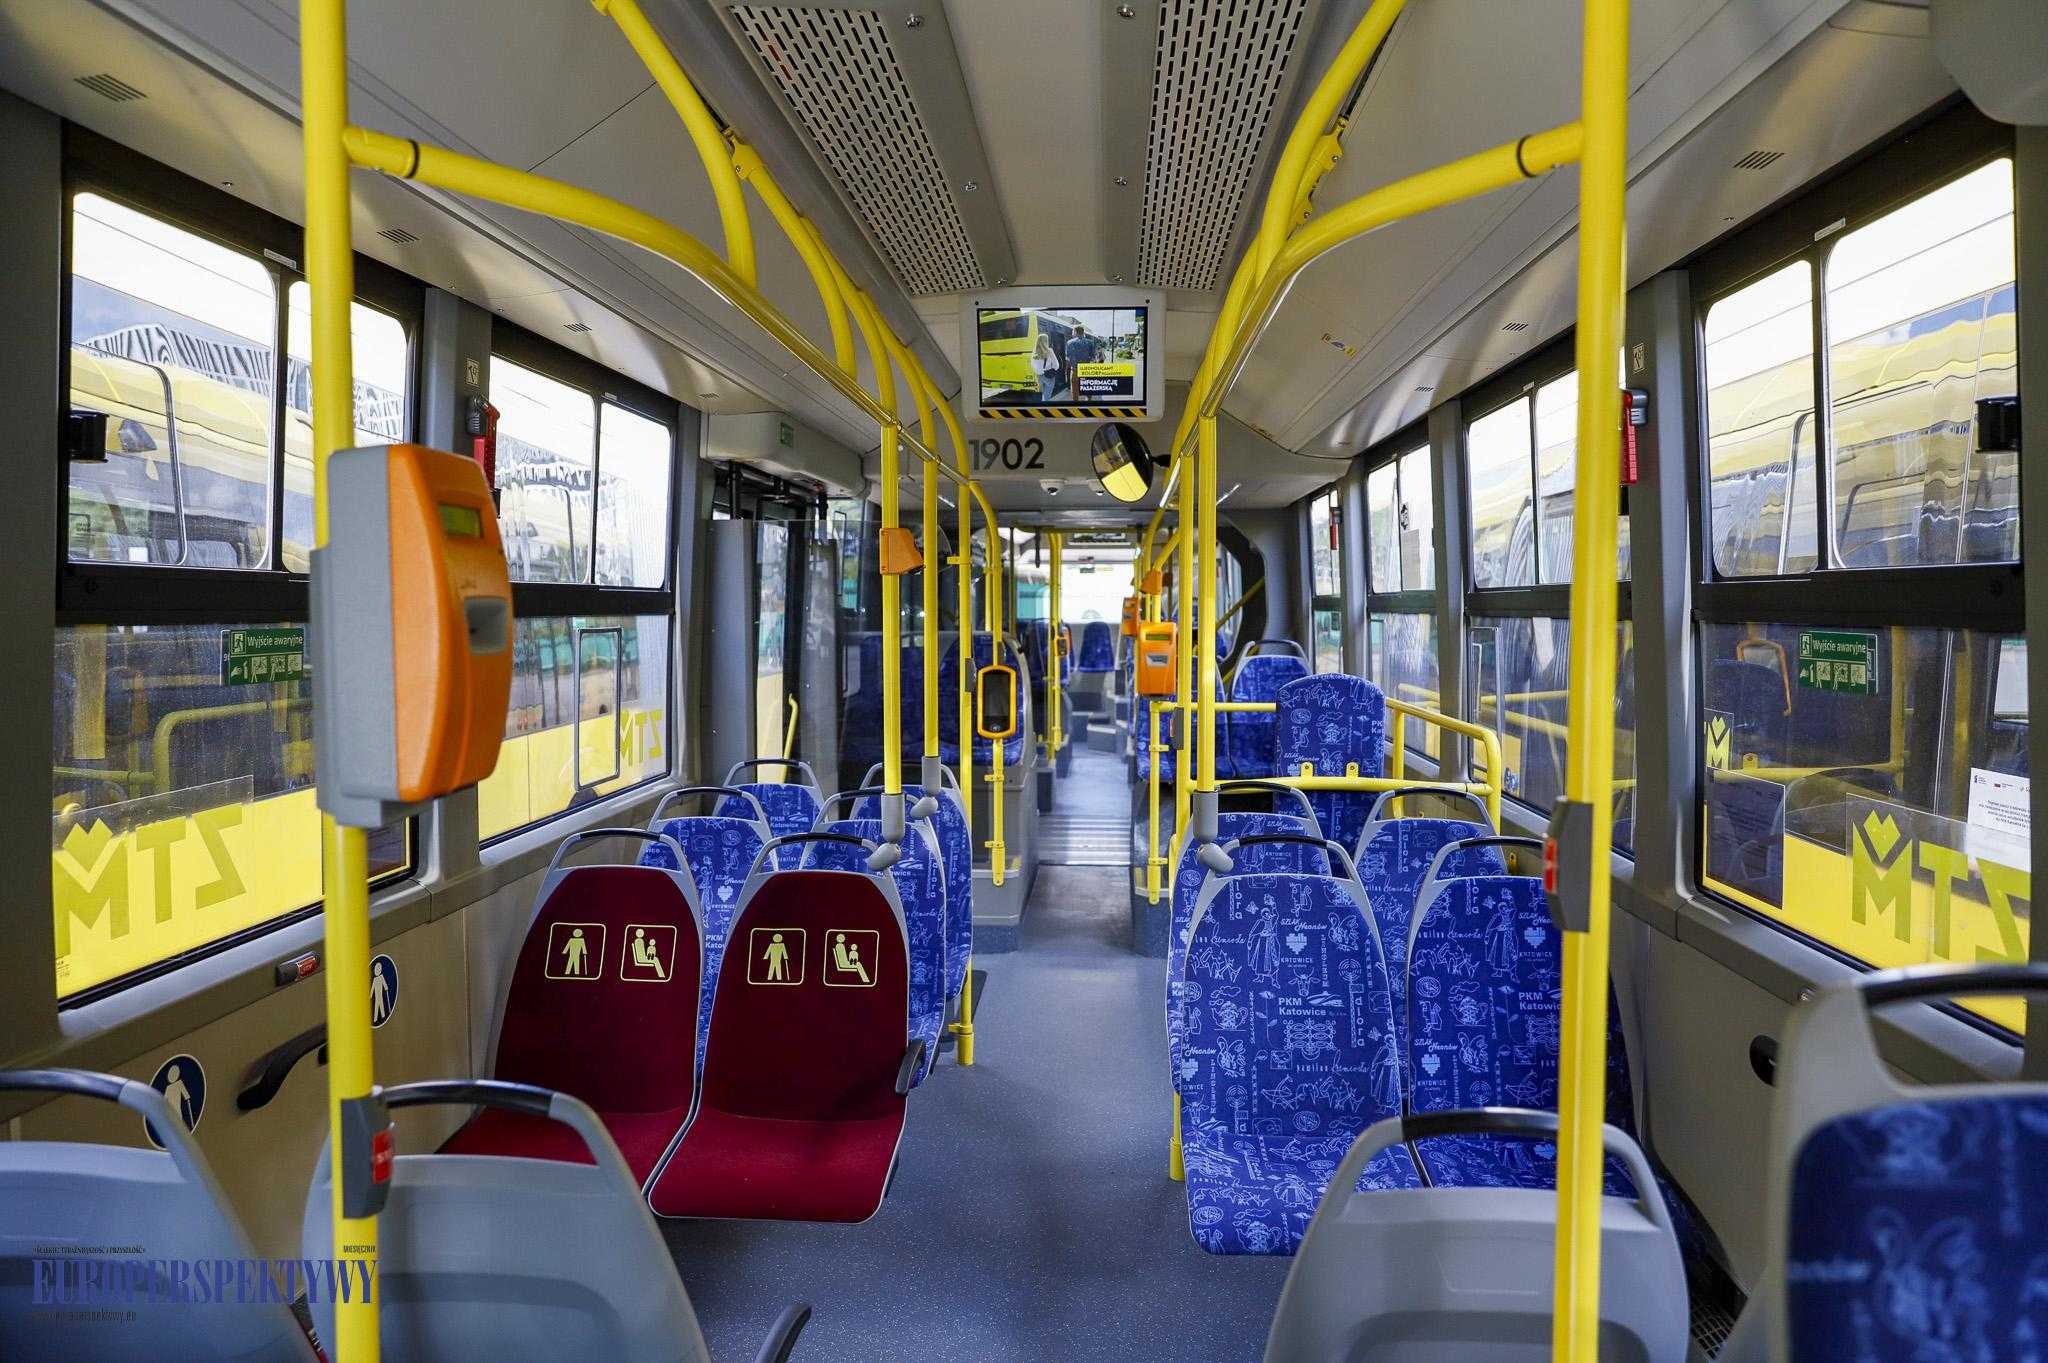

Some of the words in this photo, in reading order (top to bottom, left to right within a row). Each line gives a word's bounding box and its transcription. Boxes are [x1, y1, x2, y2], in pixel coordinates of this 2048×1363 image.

[969, 438, 1044, 470] 1902
[247, 636, 272, 648] Wyjście
[1812, 640, 1836, 653] Wyjście
[1836, 642, 1866, 655] awaryjne
[1518, 992, 1543, 1000] PKM
[1279, 997, 1301, 1006] PKM
[1520, 1002, 1562, 1010] Katowic
[1279, 1007, 1327, 1016] Katowice
